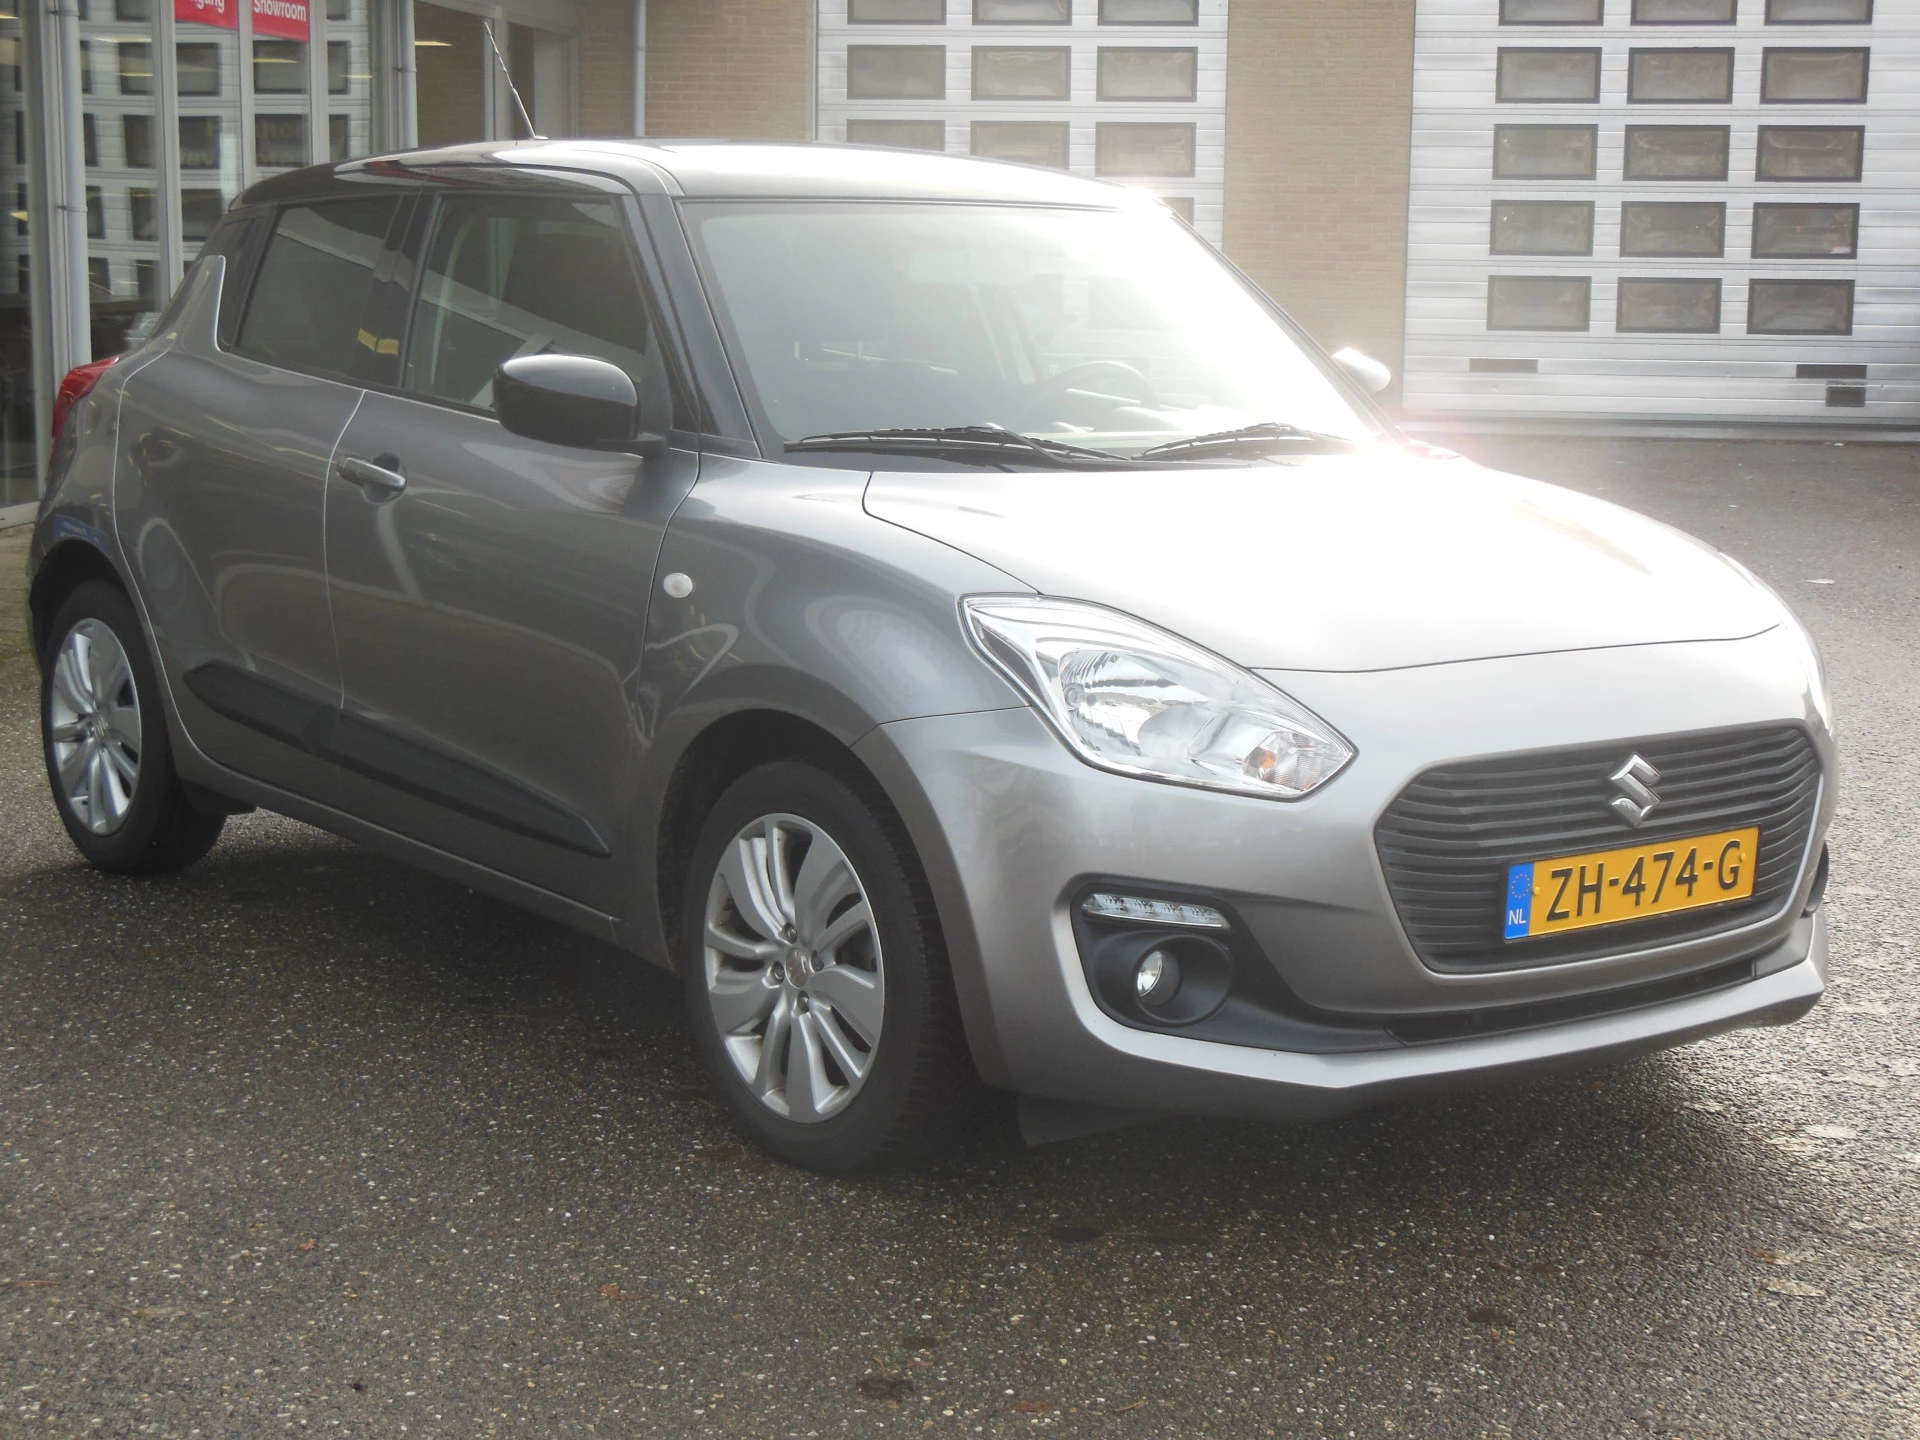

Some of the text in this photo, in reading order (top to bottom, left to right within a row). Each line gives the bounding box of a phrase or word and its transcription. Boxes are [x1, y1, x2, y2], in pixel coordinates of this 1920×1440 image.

[253, 0, 307, 22] Showroom
[1546, 839, 1741, 922] ZH-474-G
[1508, 908, 1526, 926] NL
